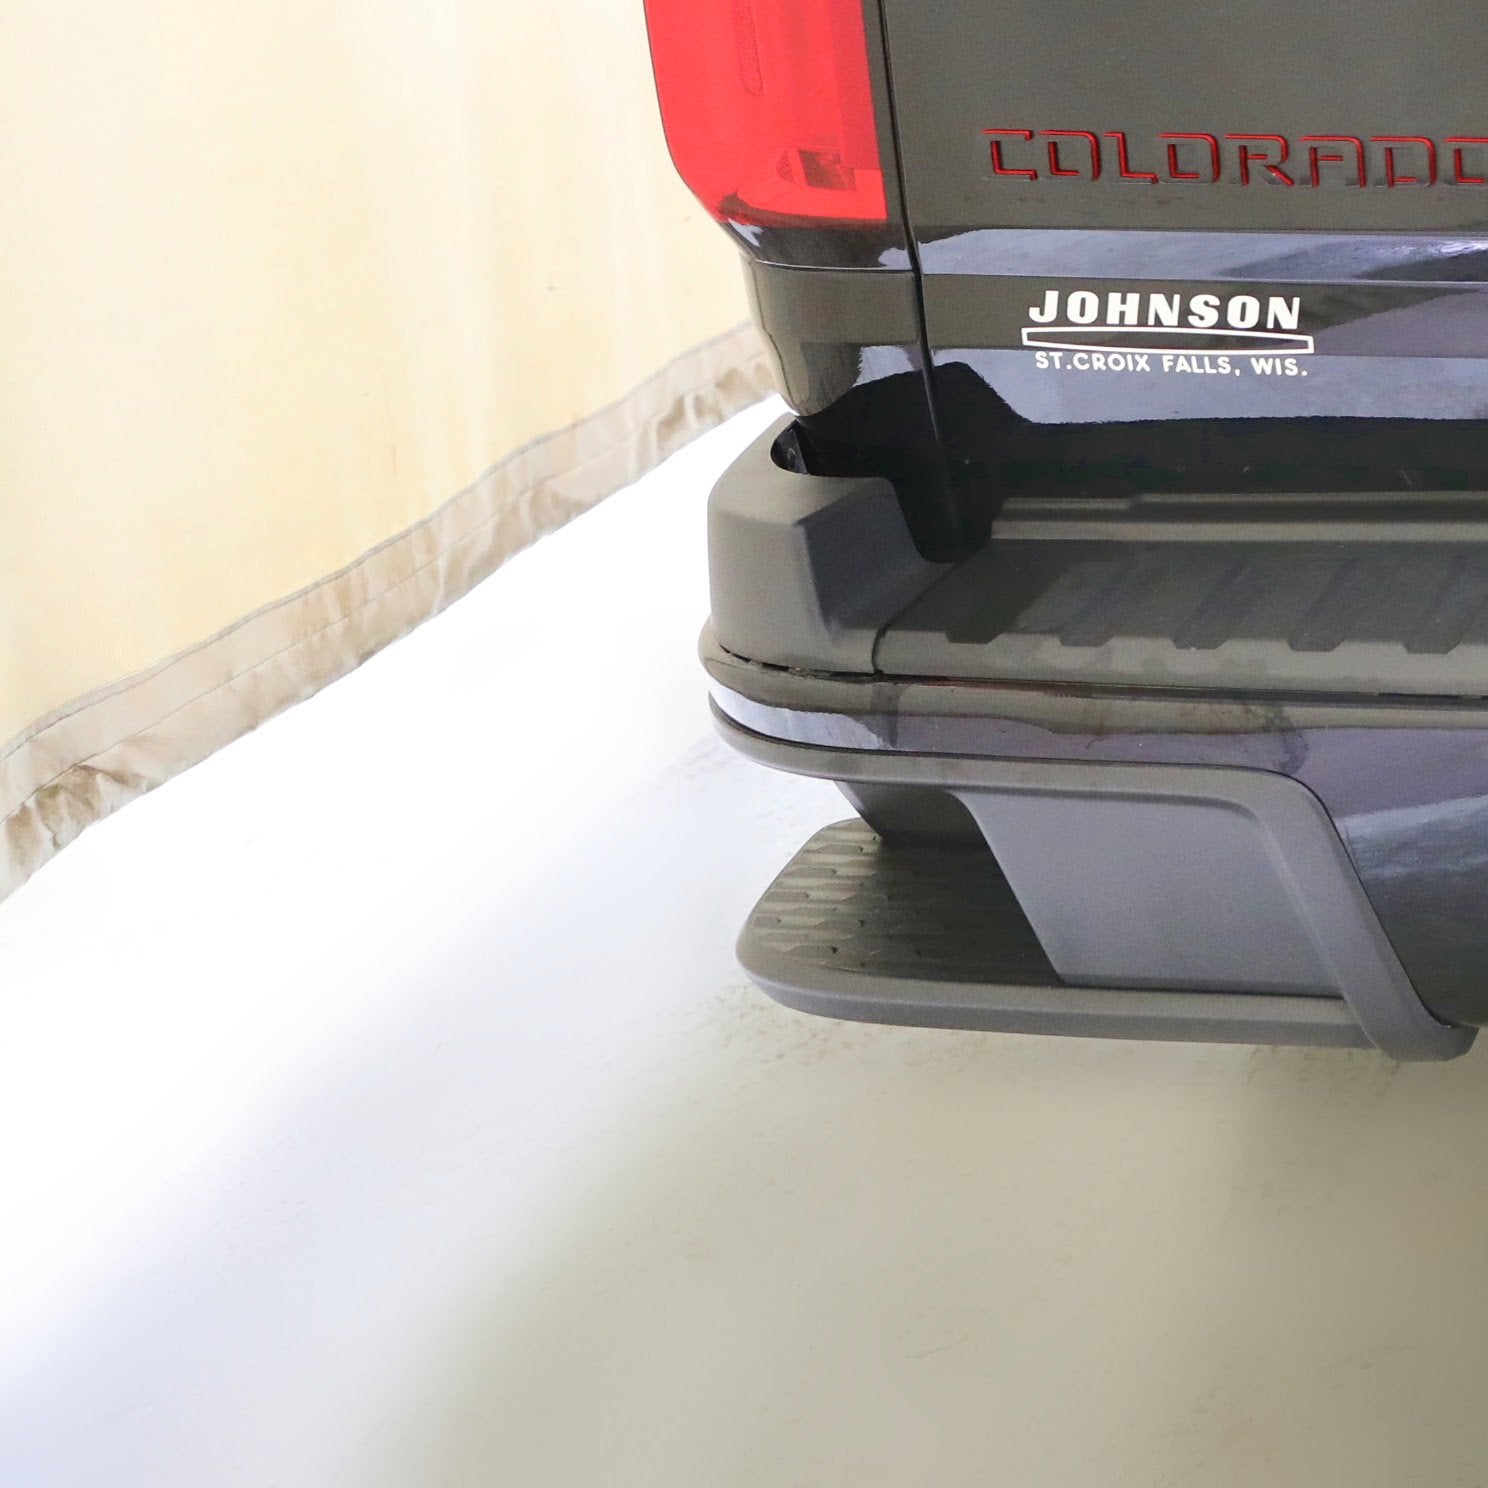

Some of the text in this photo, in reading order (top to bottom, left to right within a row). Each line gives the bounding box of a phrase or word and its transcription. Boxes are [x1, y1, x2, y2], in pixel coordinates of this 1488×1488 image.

[1028, 290, 1300, 330] JOHNSON
[1162, 354, 1240, 378] FALLS,
[1251, 357, 1308, 377] WIS.
